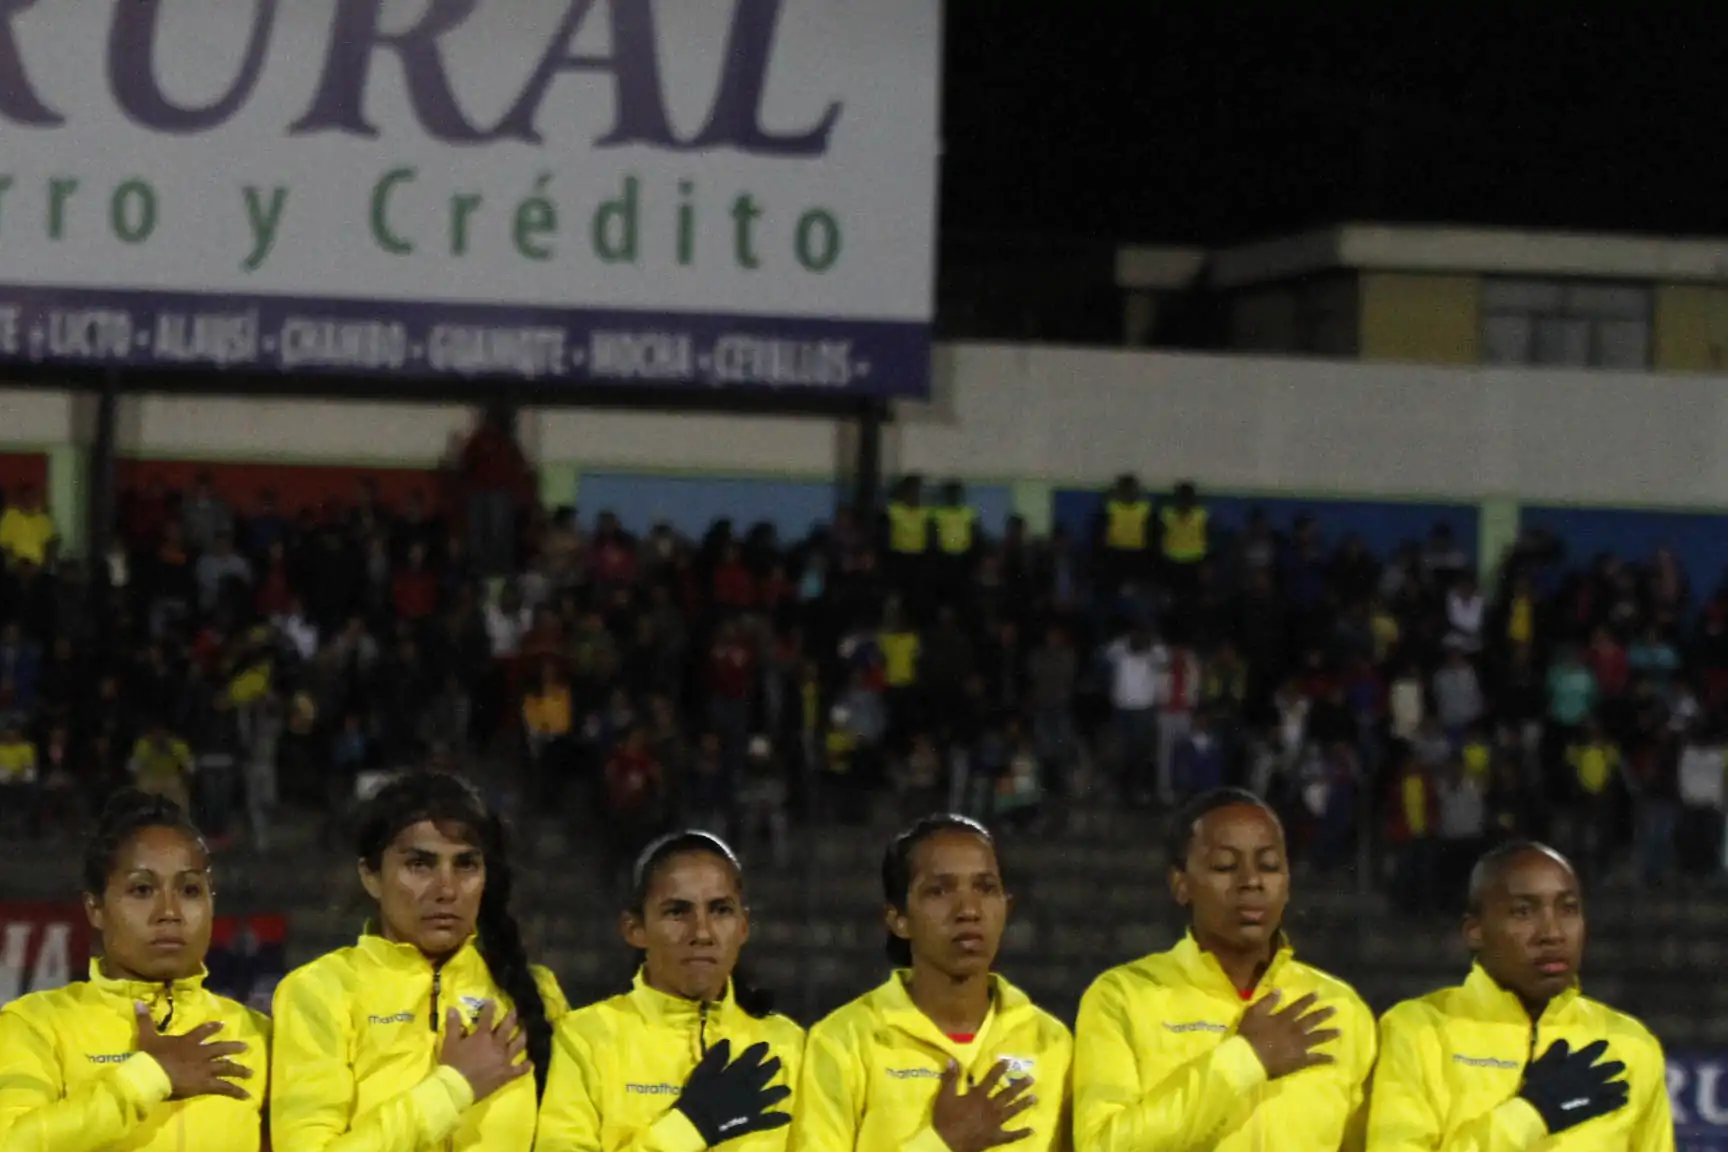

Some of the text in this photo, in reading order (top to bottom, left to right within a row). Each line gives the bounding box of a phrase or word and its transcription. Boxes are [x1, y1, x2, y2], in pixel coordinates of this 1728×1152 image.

[240, 184, 287, 271] y
[370, 167, 843, 273] Crédito
[625, 1083, 682, 1096] maratho
